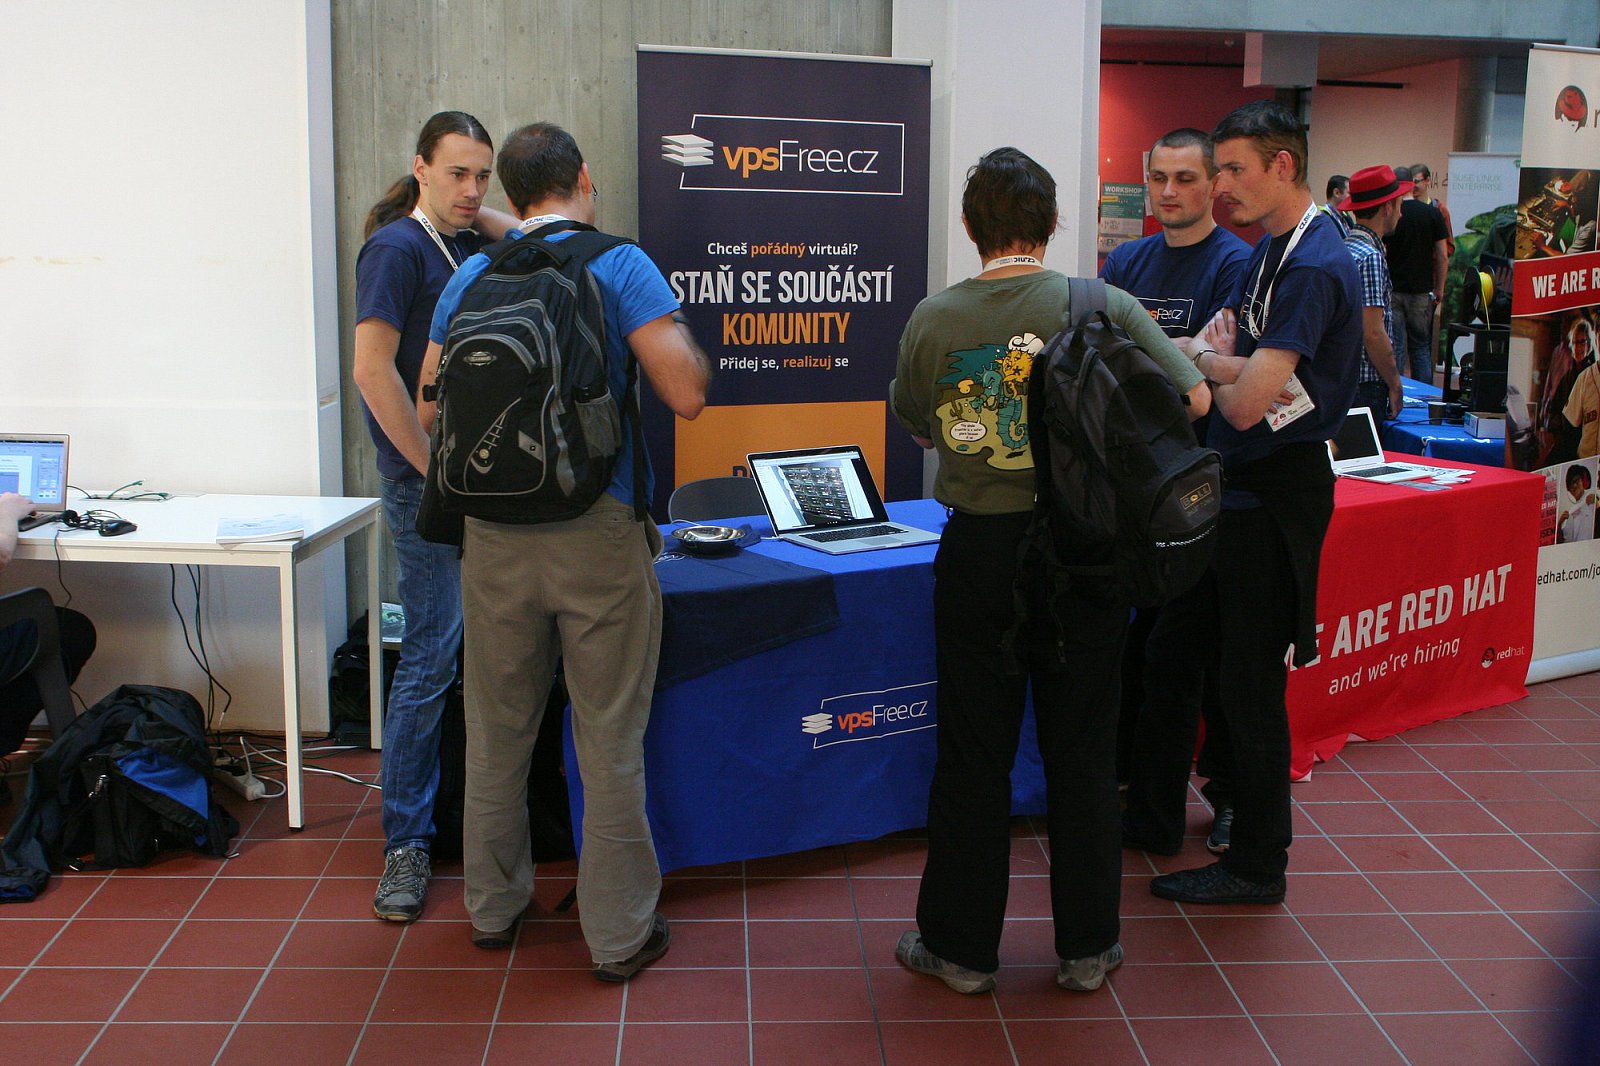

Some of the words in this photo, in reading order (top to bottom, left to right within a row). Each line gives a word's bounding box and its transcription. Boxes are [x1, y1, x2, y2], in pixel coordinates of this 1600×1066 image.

[722, 139, 879, 178] vpsFree.cz
[1104, 185, 1143, 194] WORKSHOP
[1452, 183, 1504, 192] ENTERPRISE
[1476, 175, 1502, 183] LINUX
[707, 242, 748, 255] Chceš
[751, 242, 806, 258] pořádný
[808, 243, 859, 255] virtuál?
[669, 264, 734, 304] STAŇ
[741, 271, 772, 304] SE
[778, 264, 895, 303] SOUČÁSTÍ
[1532, 273, 1557, 299] WE
[1560, 269, 1587, 295] ARE
[722, 312, 850, 346] KOMUNITY
[719, 357, 759, 372] Přidej
[761, 359, 780, 371] se,
[783, 355, 832, 370] realizuj
[834, 357, 849, 368] se
[1537, 563, 1600, 585] edhat.com/jo
[1330, 601, 1393, 658] ARE
[1398, 584, 1454, 634] RED
[1461, 563, 1512, 617] HAT
[1328, 666, 1362, 695] and
[1368, 653, 1408, 682] we're
[1414, 637, 1460, 665] hiring
[1496, 646, 1525, 660] redhat
[837, 700, 928, 734] vpsFree.cz
